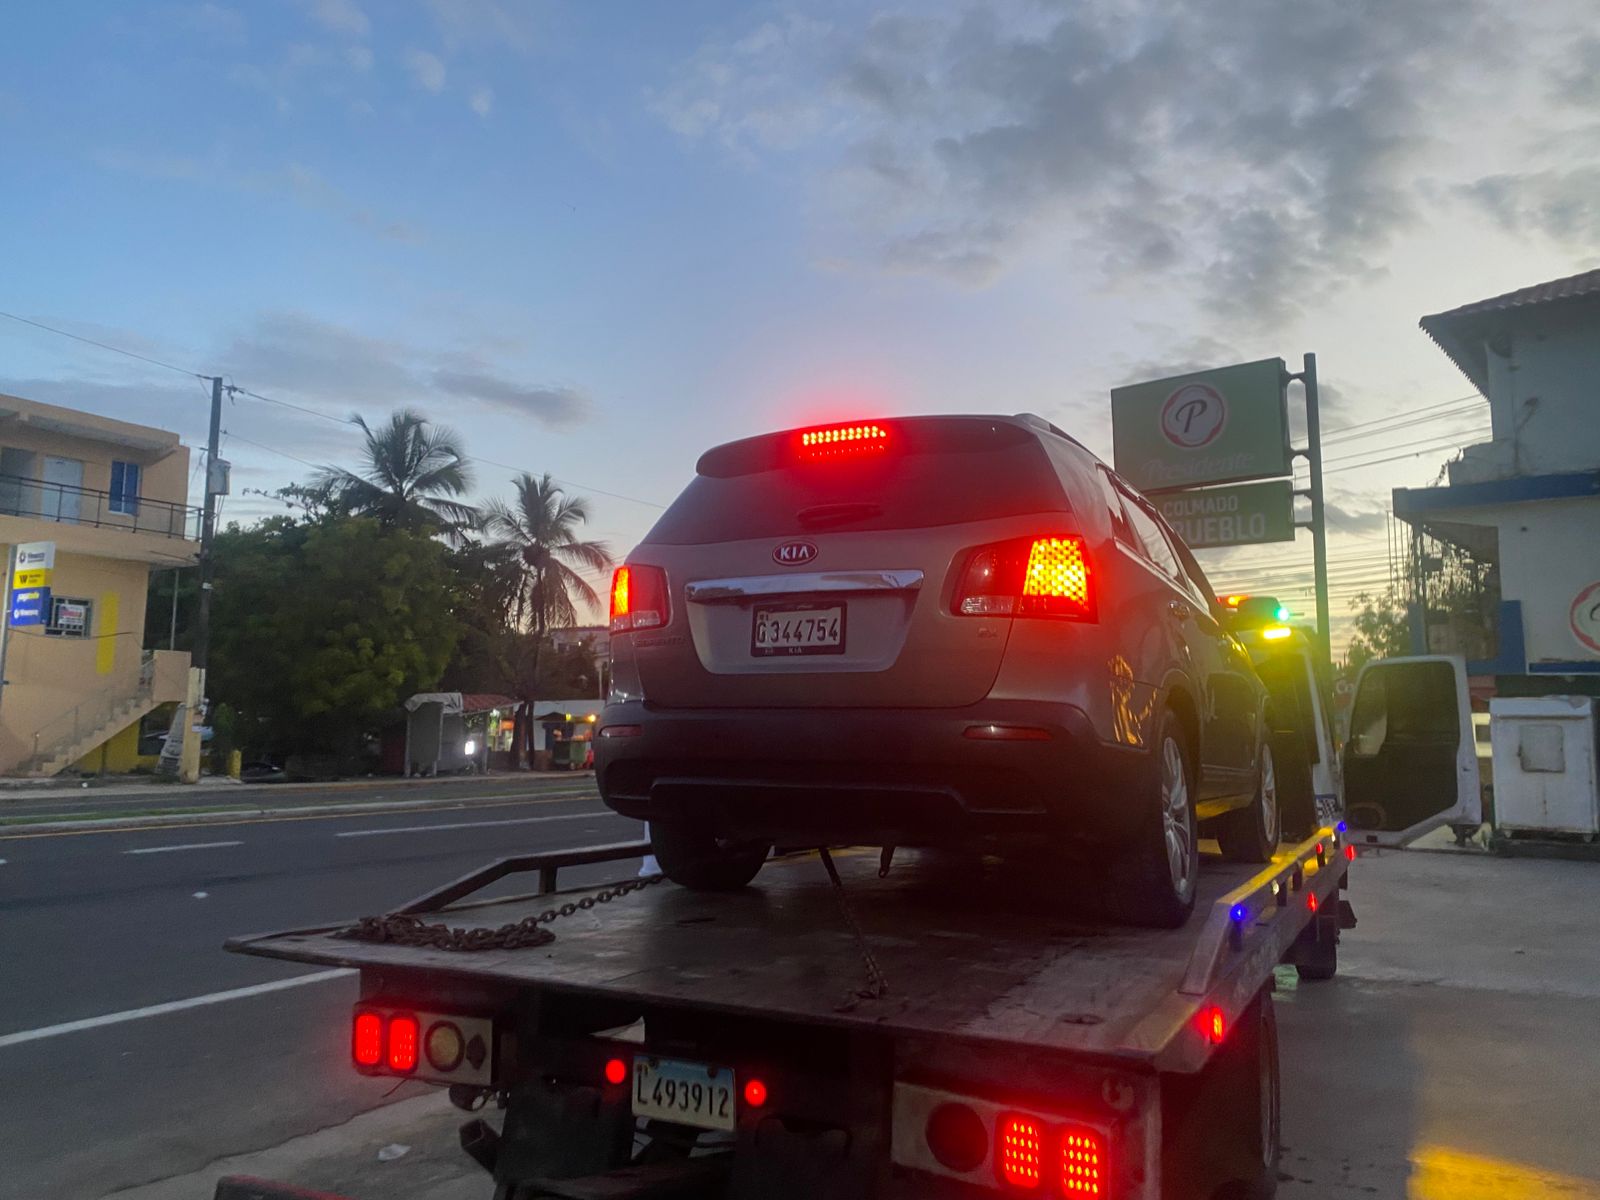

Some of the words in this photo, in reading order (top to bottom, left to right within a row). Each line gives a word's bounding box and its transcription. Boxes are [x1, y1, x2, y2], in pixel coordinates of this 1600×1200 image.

[1163, 496, 1239, 517] COLMADO
[780, 545, 810, 560] KIA
[757, 617, 838, 643] G344754
[637, 1072, 729, 1119] L493912
